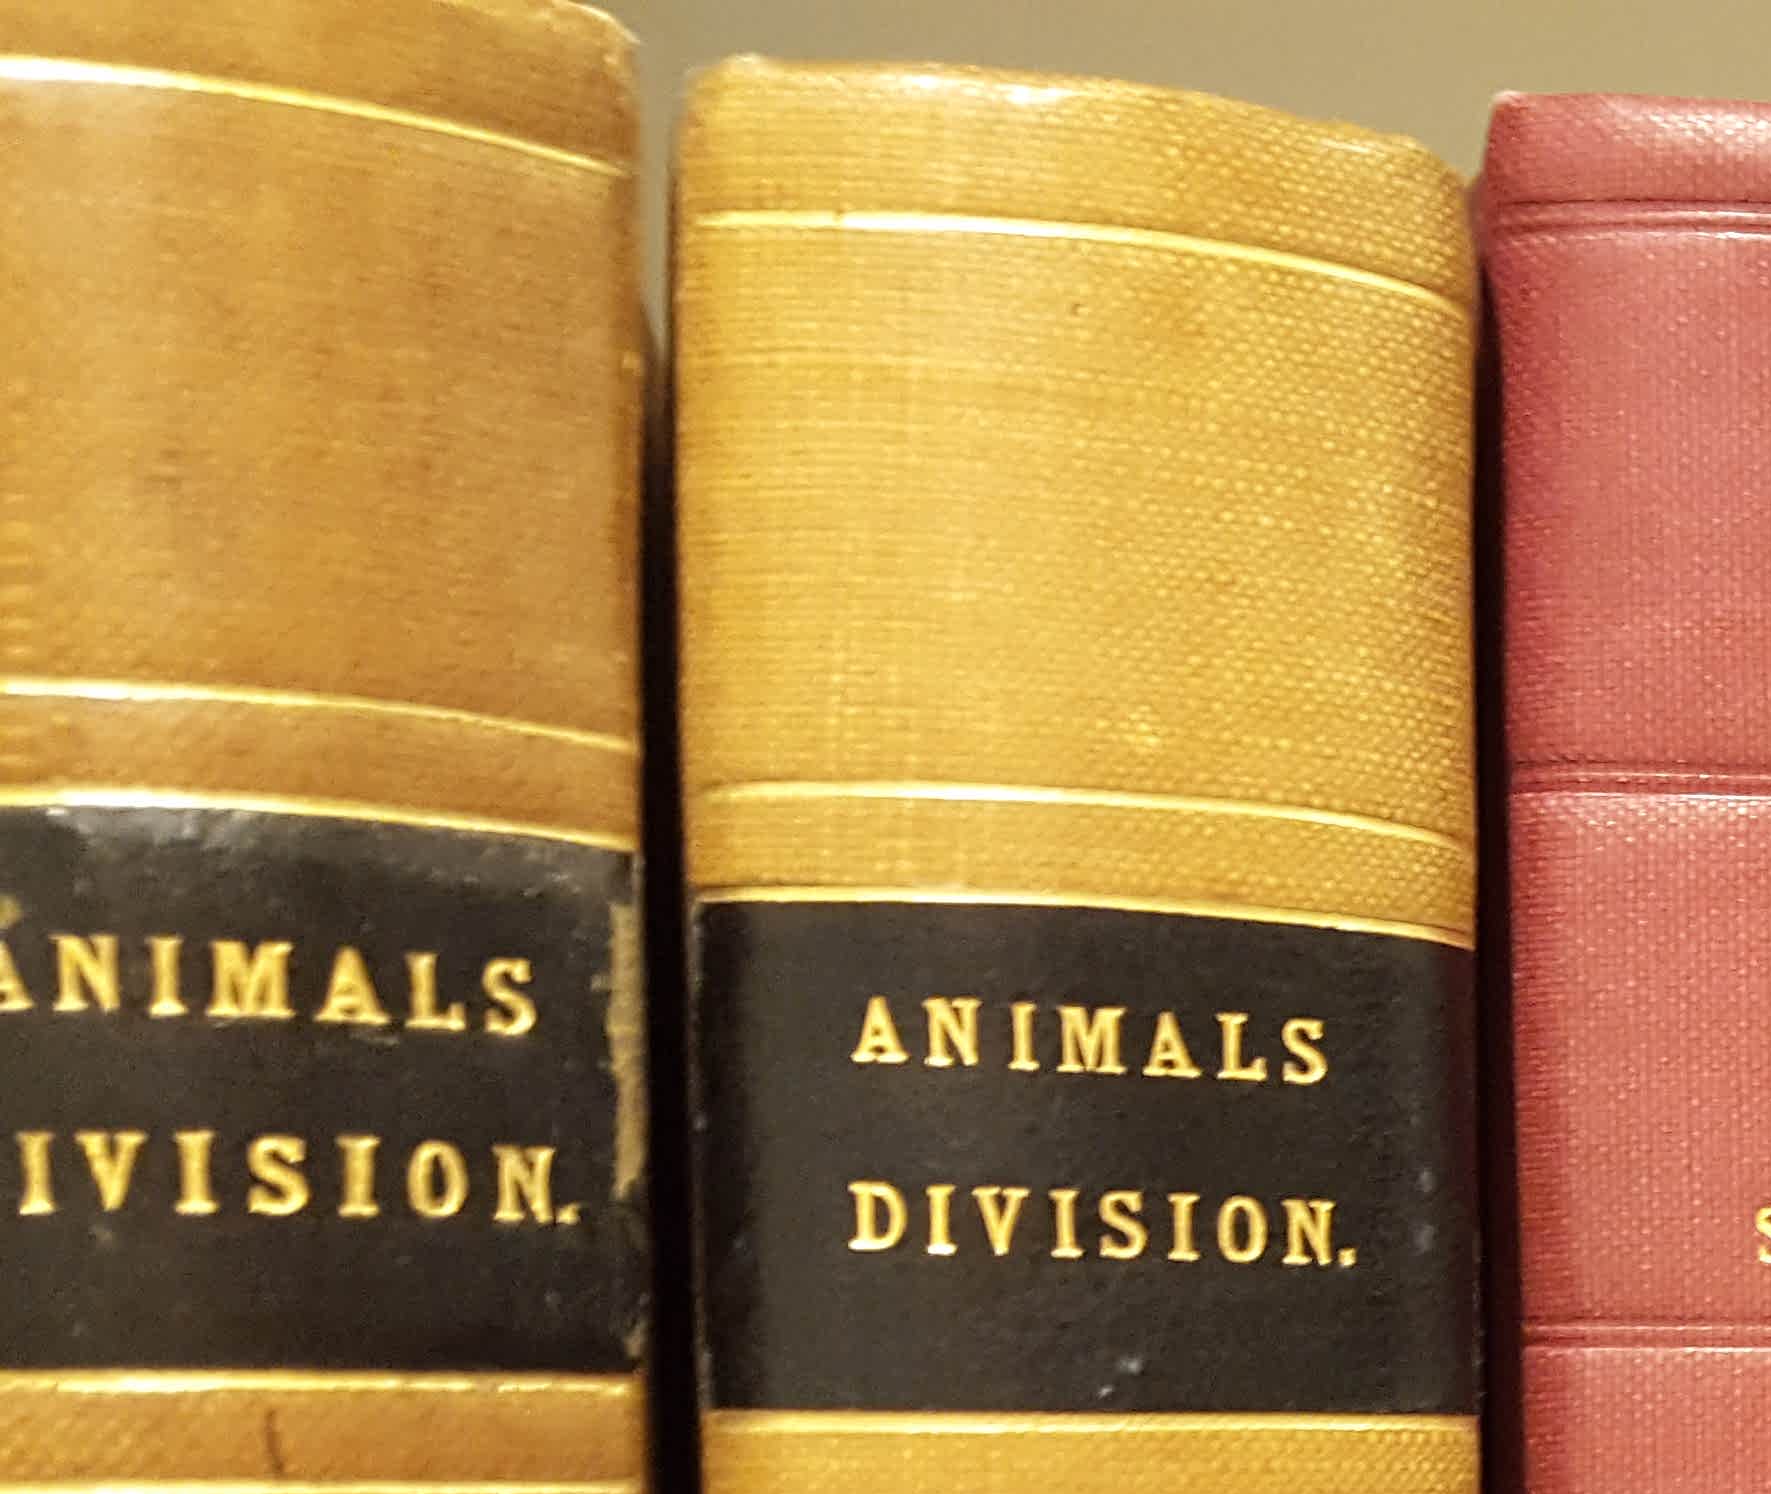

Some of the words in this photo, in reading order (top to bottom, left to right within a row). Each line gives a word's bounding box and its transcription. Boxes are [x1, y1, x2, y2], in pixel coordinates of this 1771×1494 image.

[850, 996, 1331, 1084] ANIMALS
[14, 1129, 581, 1224] IVISION.
[847, 1180, 1358, 1267] DIVISION.
